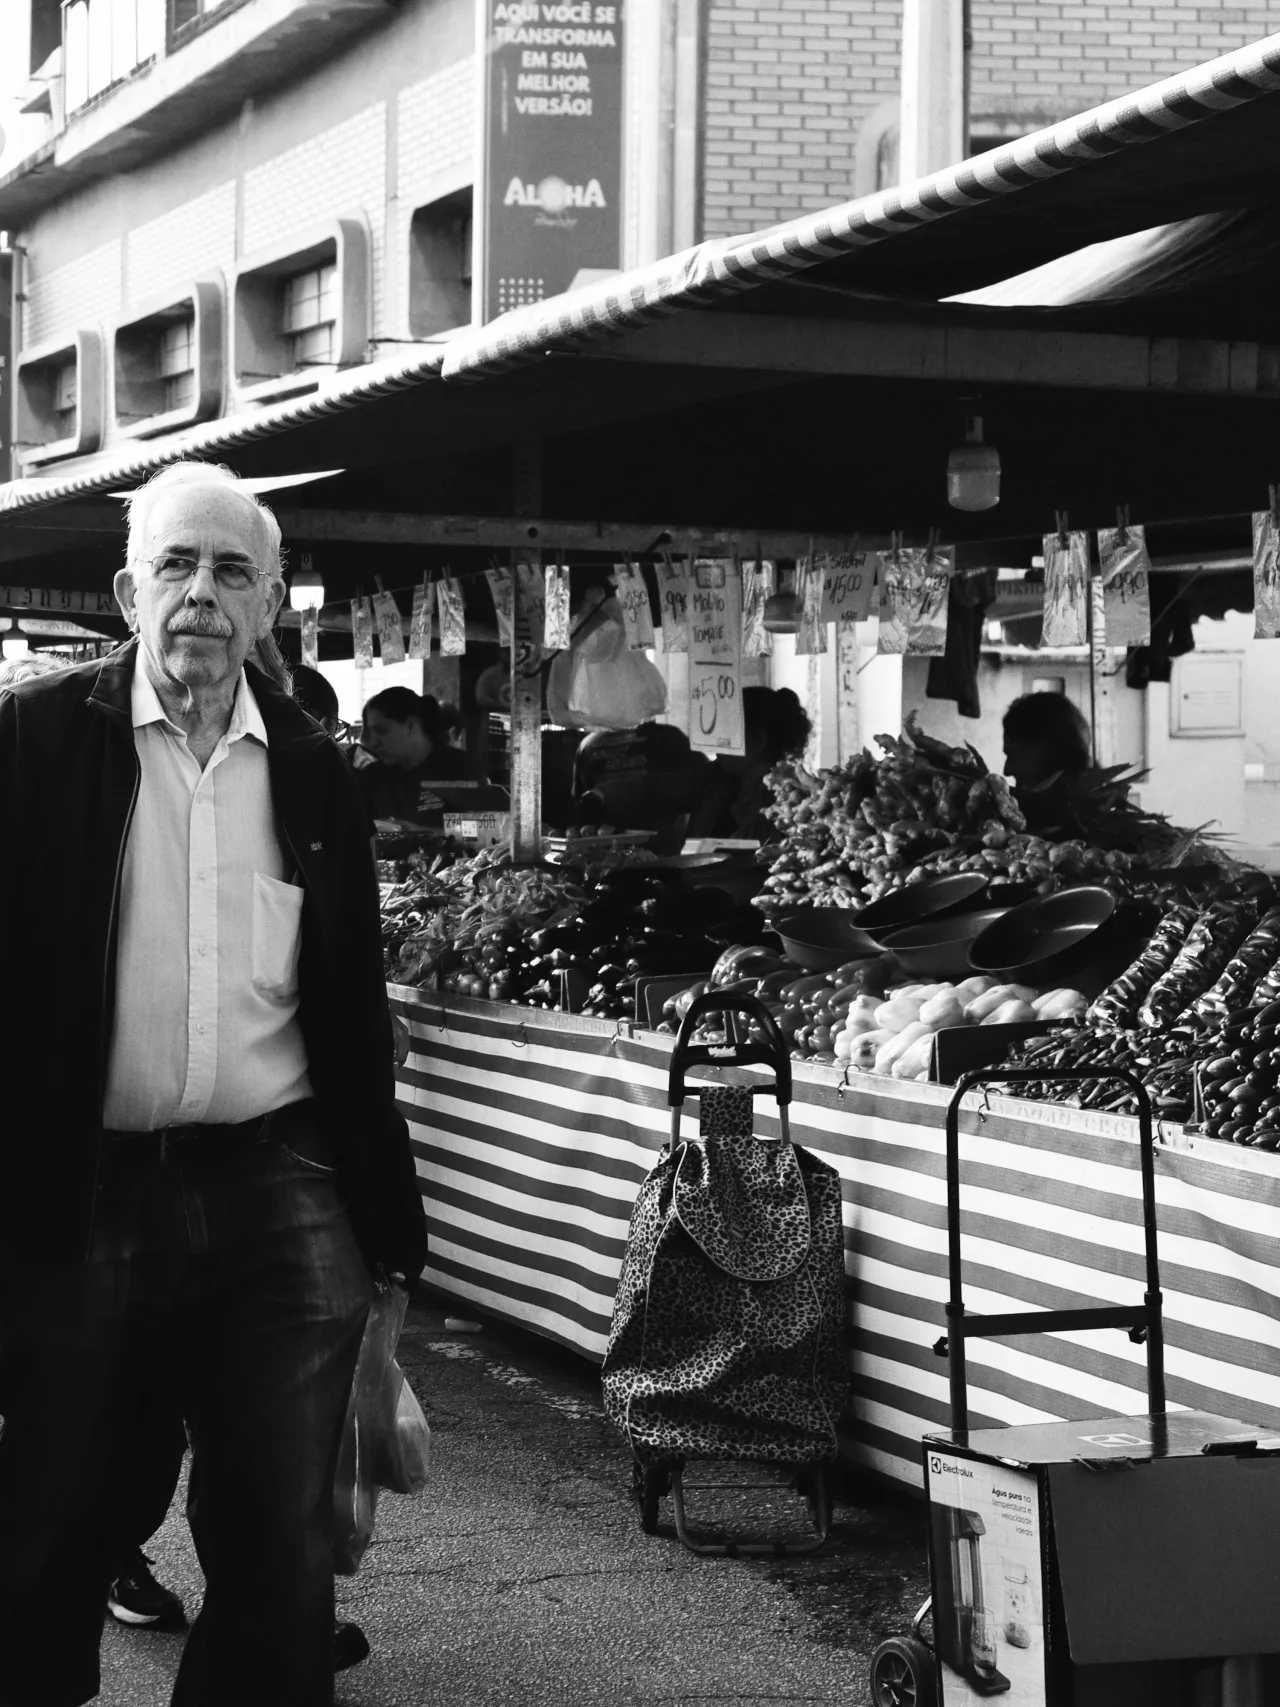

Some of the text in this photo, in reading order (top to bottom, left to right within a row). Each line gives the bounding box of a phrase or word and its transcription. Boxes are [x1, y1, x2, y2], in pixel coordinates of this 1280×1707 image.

[494, 1, 616, 24] AQUI VOCÊ SE
[494, 26, 616, 47] TRANSFORMA
[522, 50, 588, 69] EM SUA
[517, 74, 590, 93] MELHOR
[514, 94, 593, 116] VERSÃO!
[0, 356, 5, 367] E
[943, 1463, 974, 1478] Electrolux
[992, 1485, 1007, 1498] Água
[1009, 1492, 1023, 1500] pura
